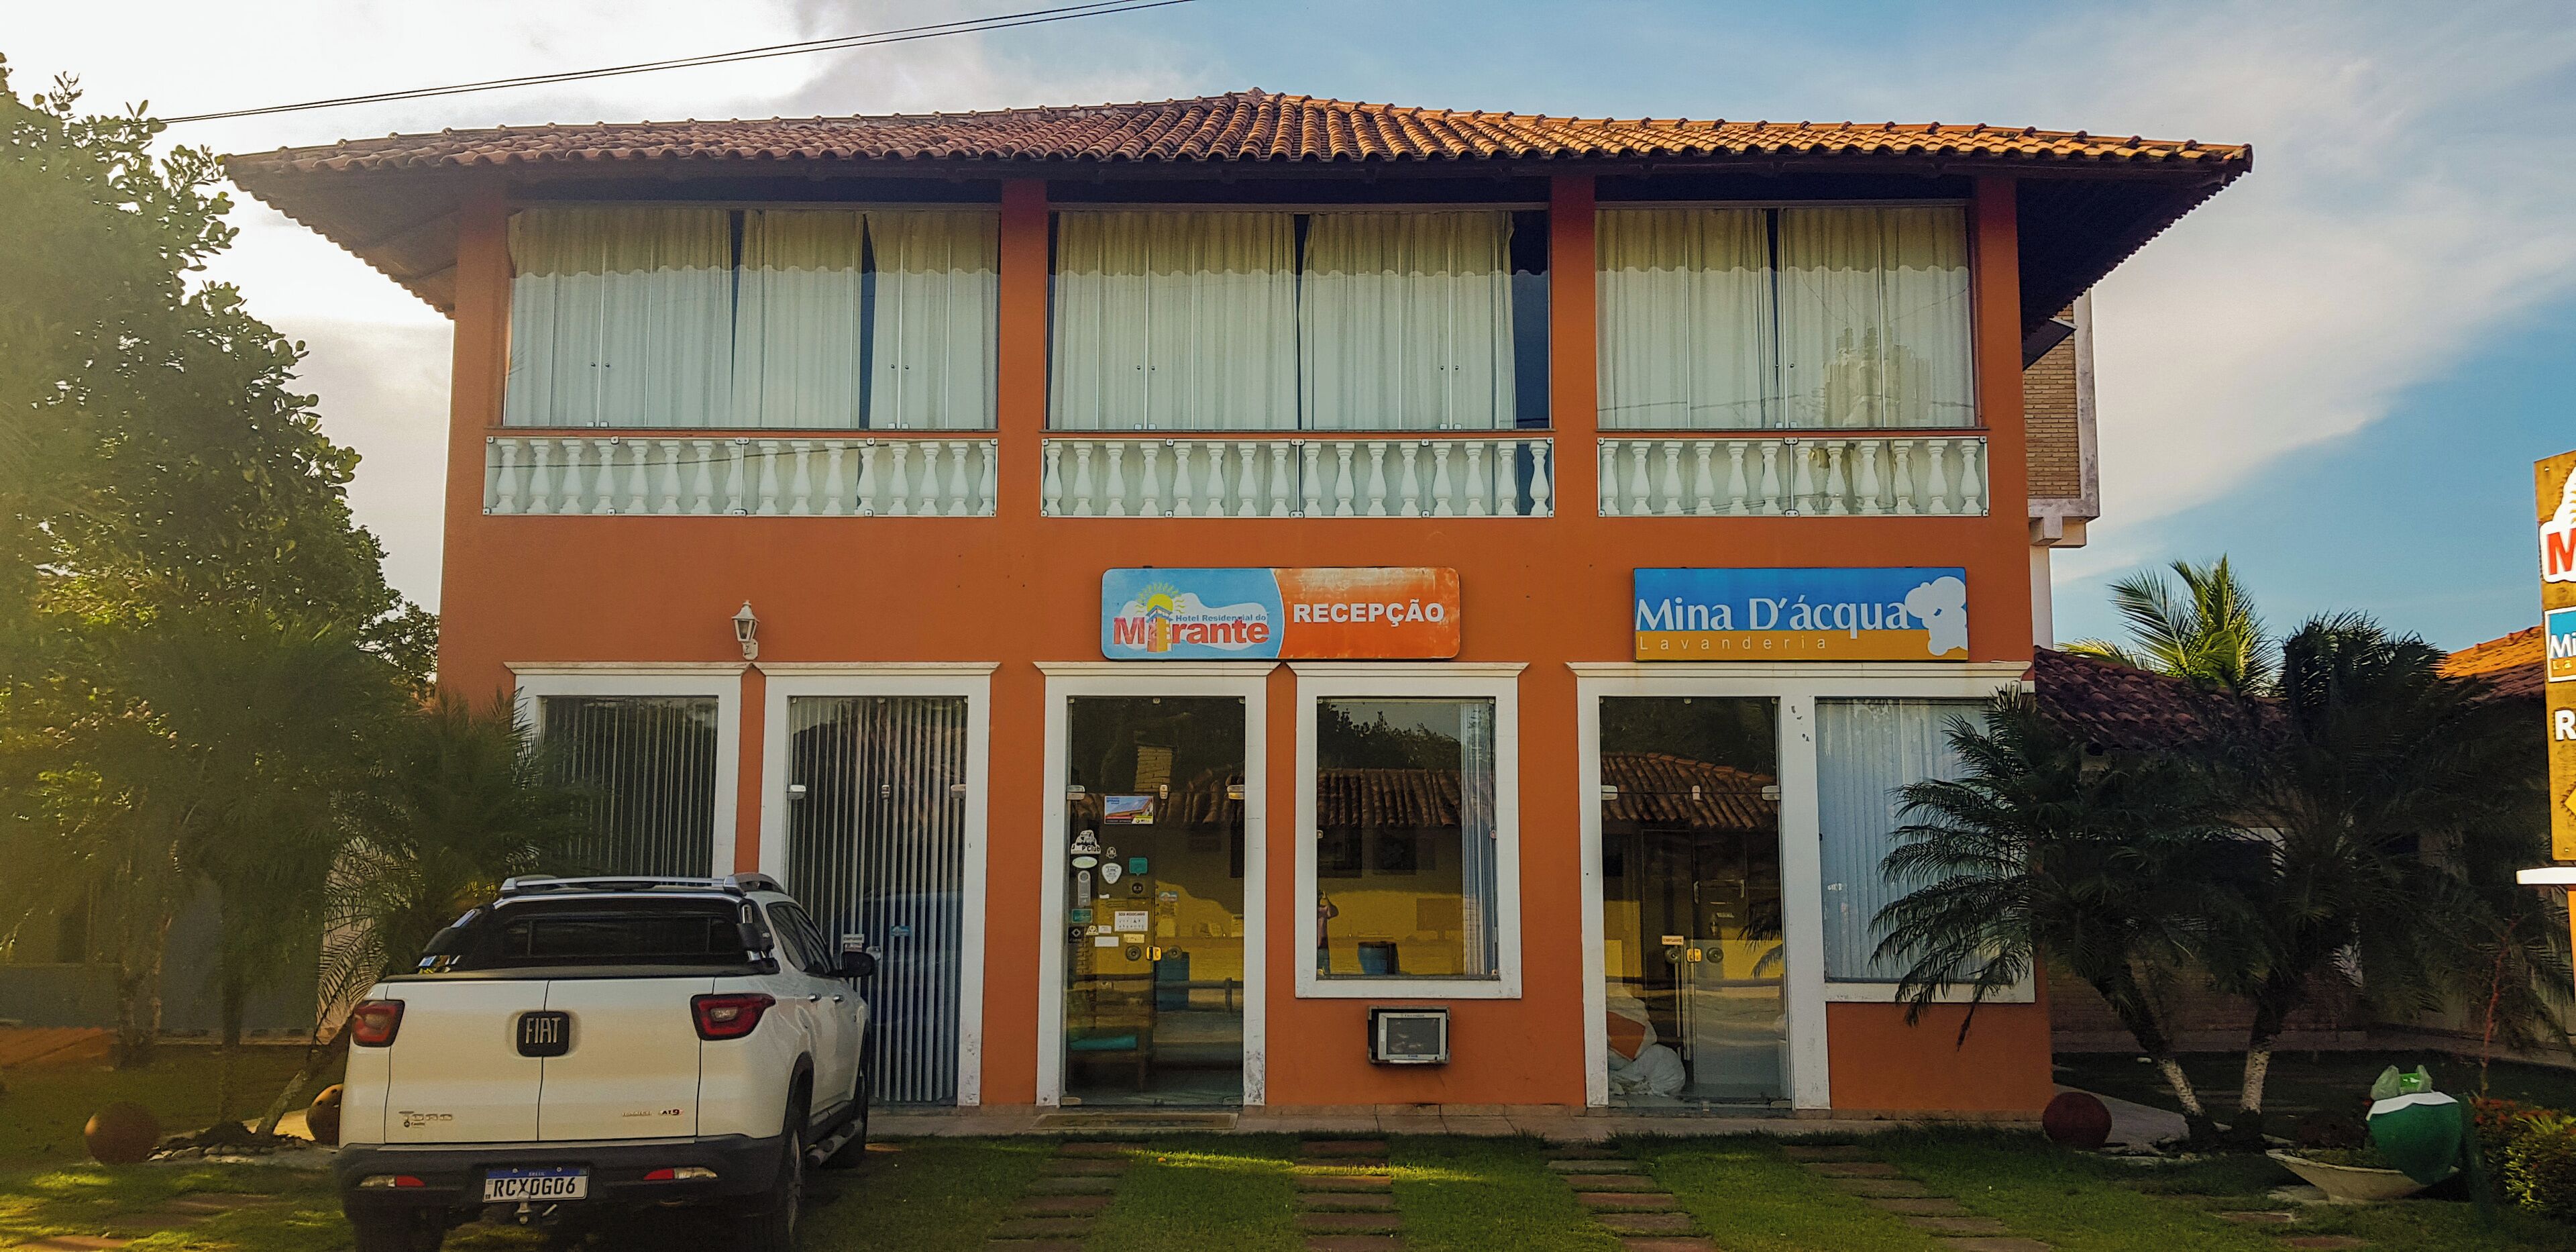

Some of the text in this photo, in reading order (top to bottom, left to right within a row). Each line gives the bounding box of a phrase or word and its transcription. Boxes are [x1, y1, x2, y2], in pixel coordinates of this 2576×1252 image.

[1175, 614, 1199, 622] Hotel
[1255, 613, 1266, 621] do
[1293, 598, 1444, 627] RECEPÇÃO
[1636, 597, 1734, 631] Mina
[1113, 616, 1270, 646] Mirante
[1639, 636, 1827, 650] Lavanderia
[525, 1017, 561, 1044] FIAT
